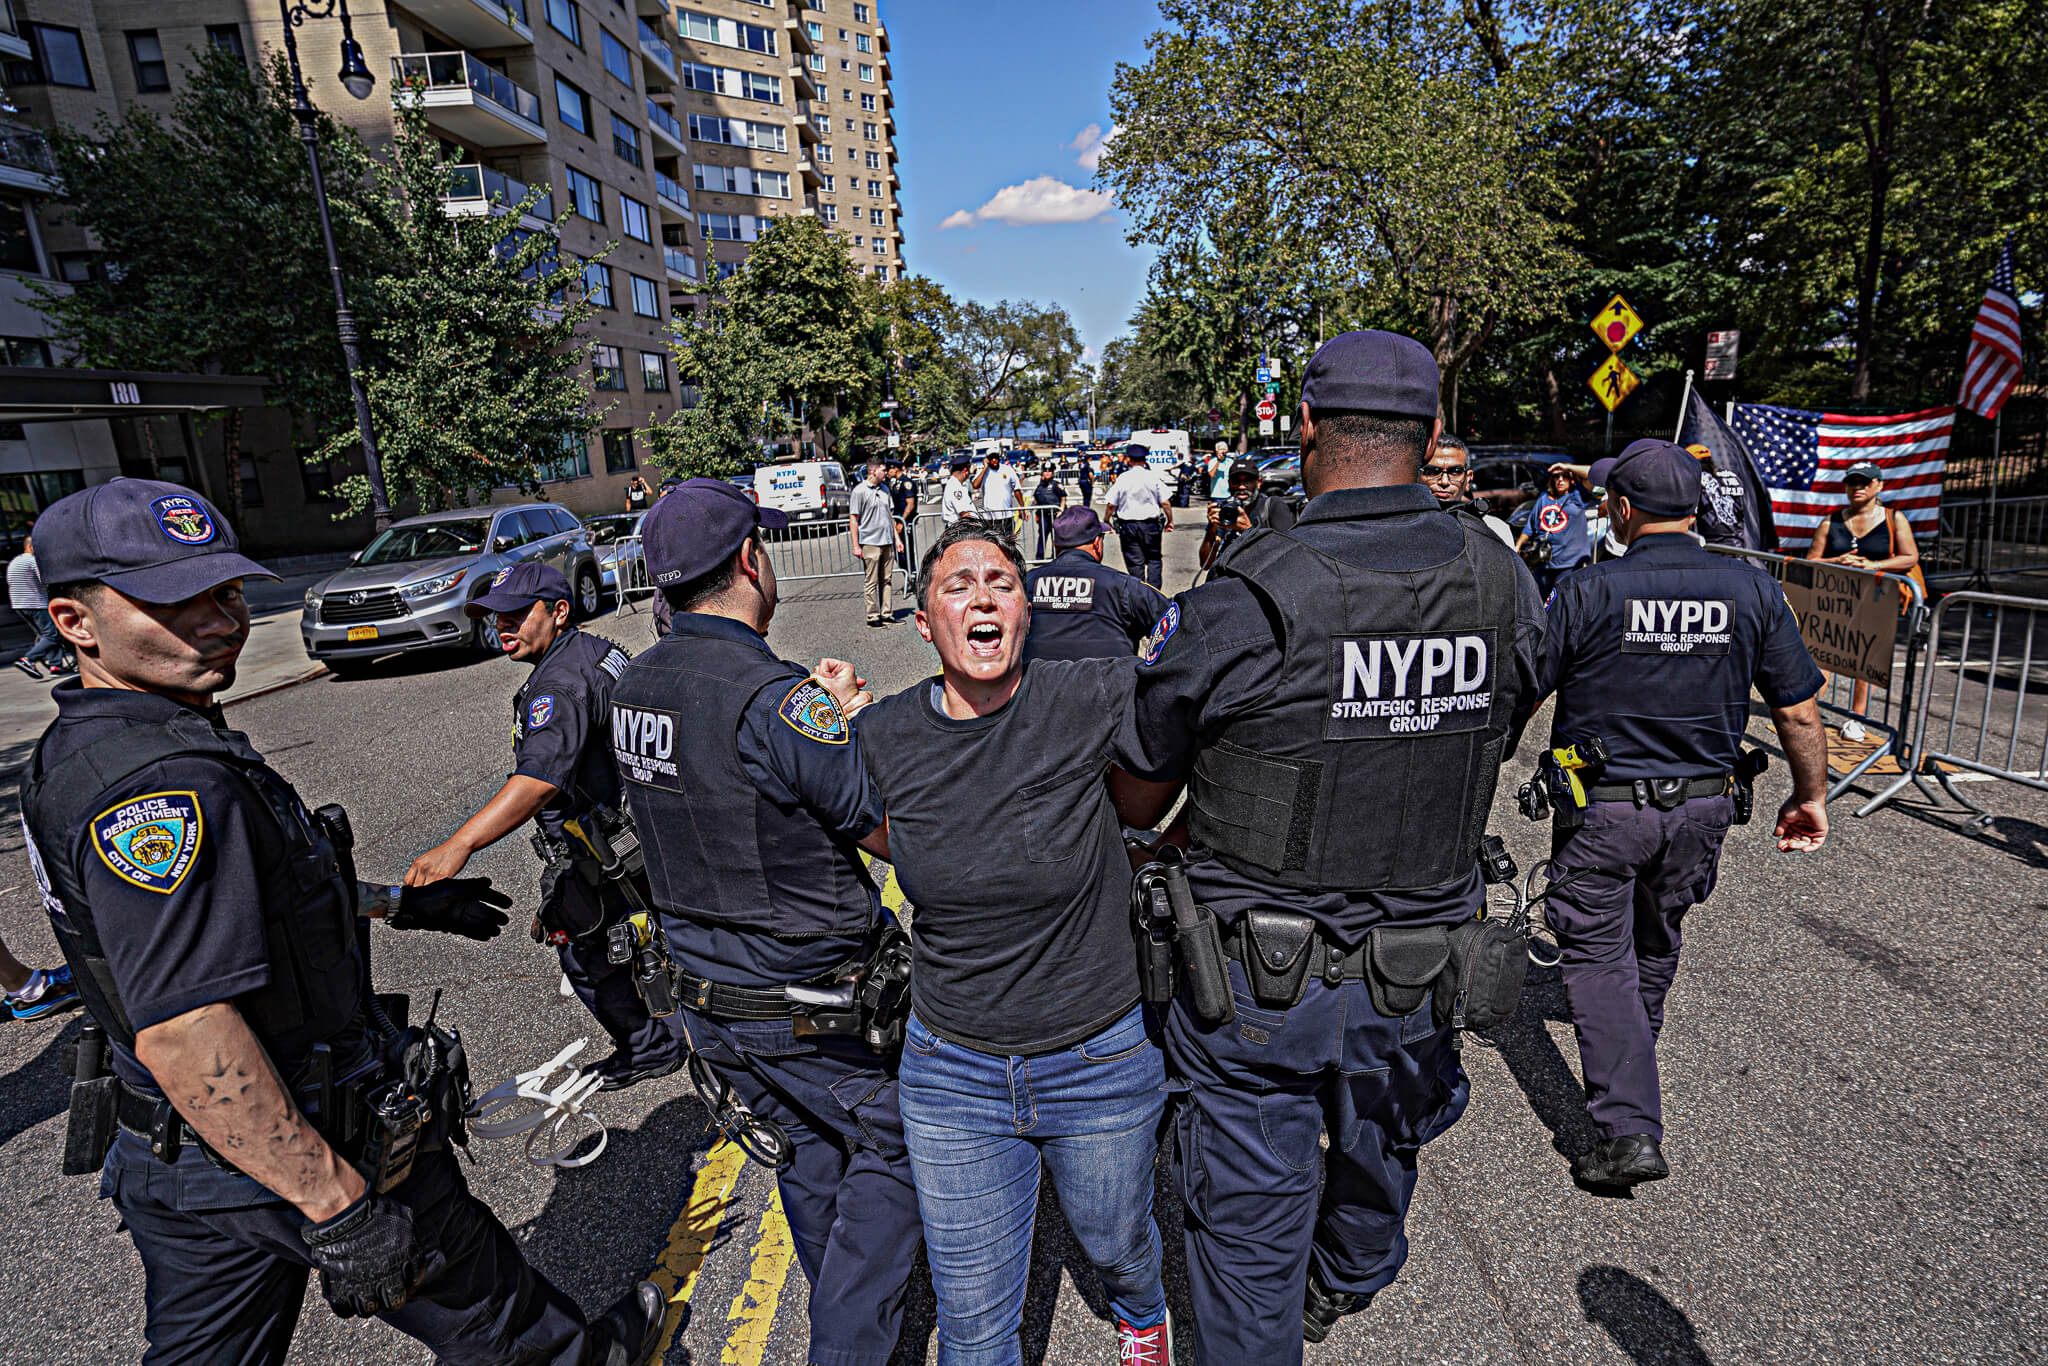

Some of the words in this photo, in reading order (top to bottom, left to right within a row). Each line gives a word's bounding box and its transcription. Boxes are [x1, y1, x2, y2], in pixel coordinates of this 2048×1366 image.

[109, 382, 141, 404] 180
[1256, 406, 1274, 416] STOP
[776, 469, 797, 477] NYPD
[773, 480, 804, 490] POLICE
[161, 498, 192, 509] NYPD
[656, 570, 682, 583] NYPD
[1036, 576, 1091, 597] NYPD
[1816, 568, 1861, 600] DOWN
[1063, 596, 1092, 604] RESPONSE
[1817, 596, 1853, 618] WITH
[1631, 600, 1728, 633] NYPD
[1625, 632, 1677, 643] STRATEGIC
[1680, 633, 1731, 644] RESPONSE
[1660, 643, 1694, 653] GROUP
[1799, 611, 1877, 671] YRANNY
[1343, 636, 1487, 699] NYPD
[790, 683, 813, 706] POLICE
[1331, 700, 1415, 718] STRATEGIC
[1421, 692, 1491, 714] RESPONSE
[613, 706, 673, 760] NYPD
[802, 725, 822, 737] CITY
[822, 731, 835, 740] OF
[1389, 714, 1440, 733] GROUP
[614, 748, 640, 768] STRATEGIC
[641, 756, 678, 776] RESPONSE
[632, 766, 653, 782] GROUP
[116, 798, 168, 822] POLICE
[102, 807, 189, 841] DEPARTMENT
[170, 853, 190, 878] NEW
[182, 821, 197, 853] YORK
[107, 850, 134, 872] CITY
[131, 870, 152, 882] OF
